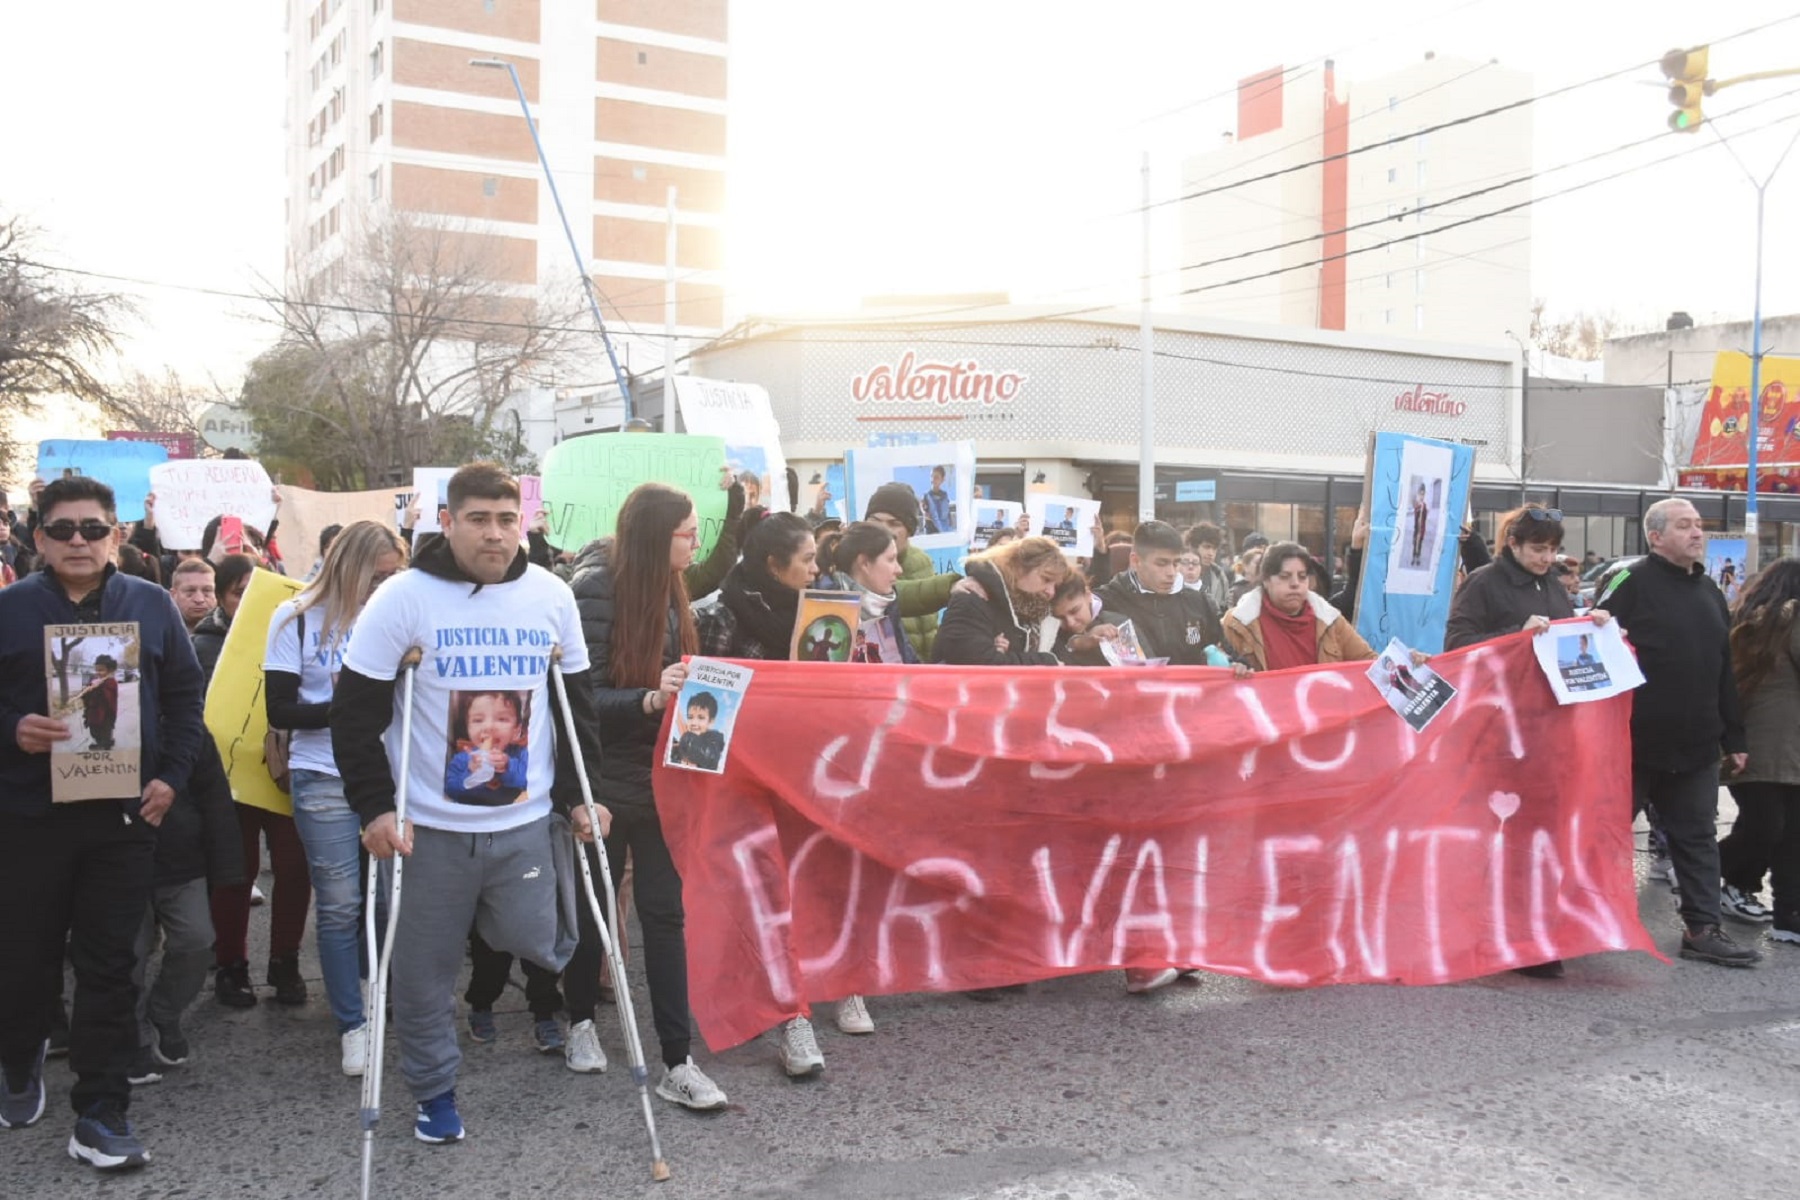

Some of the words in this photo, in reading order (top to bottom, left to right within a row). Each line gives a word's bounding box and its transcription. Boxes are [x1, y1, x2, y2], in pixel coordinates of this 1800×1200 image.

[698, 387, 754, 411] JUSTICIA
[54, 623, 136, 637] JUSTICIA
[436, 627, 509, 650] JUSTICIA
[516, 628, 550, 647] POR
[435, 655, 549, 678] VALENTIN
[697, 663, 726, 675] JUSTICIA
[727, 669, 742, 680] POR
[697, 672, 735, 688] VALENTIN
[813, 648, 1524, 798] JUSTICIA
[77, 751, 113, 762] POR
[58, 762, 138, 780] VALENTIN
[1032, 788, 1626, 985] VALENTIN
[731, 822, 983, 1004] POR
